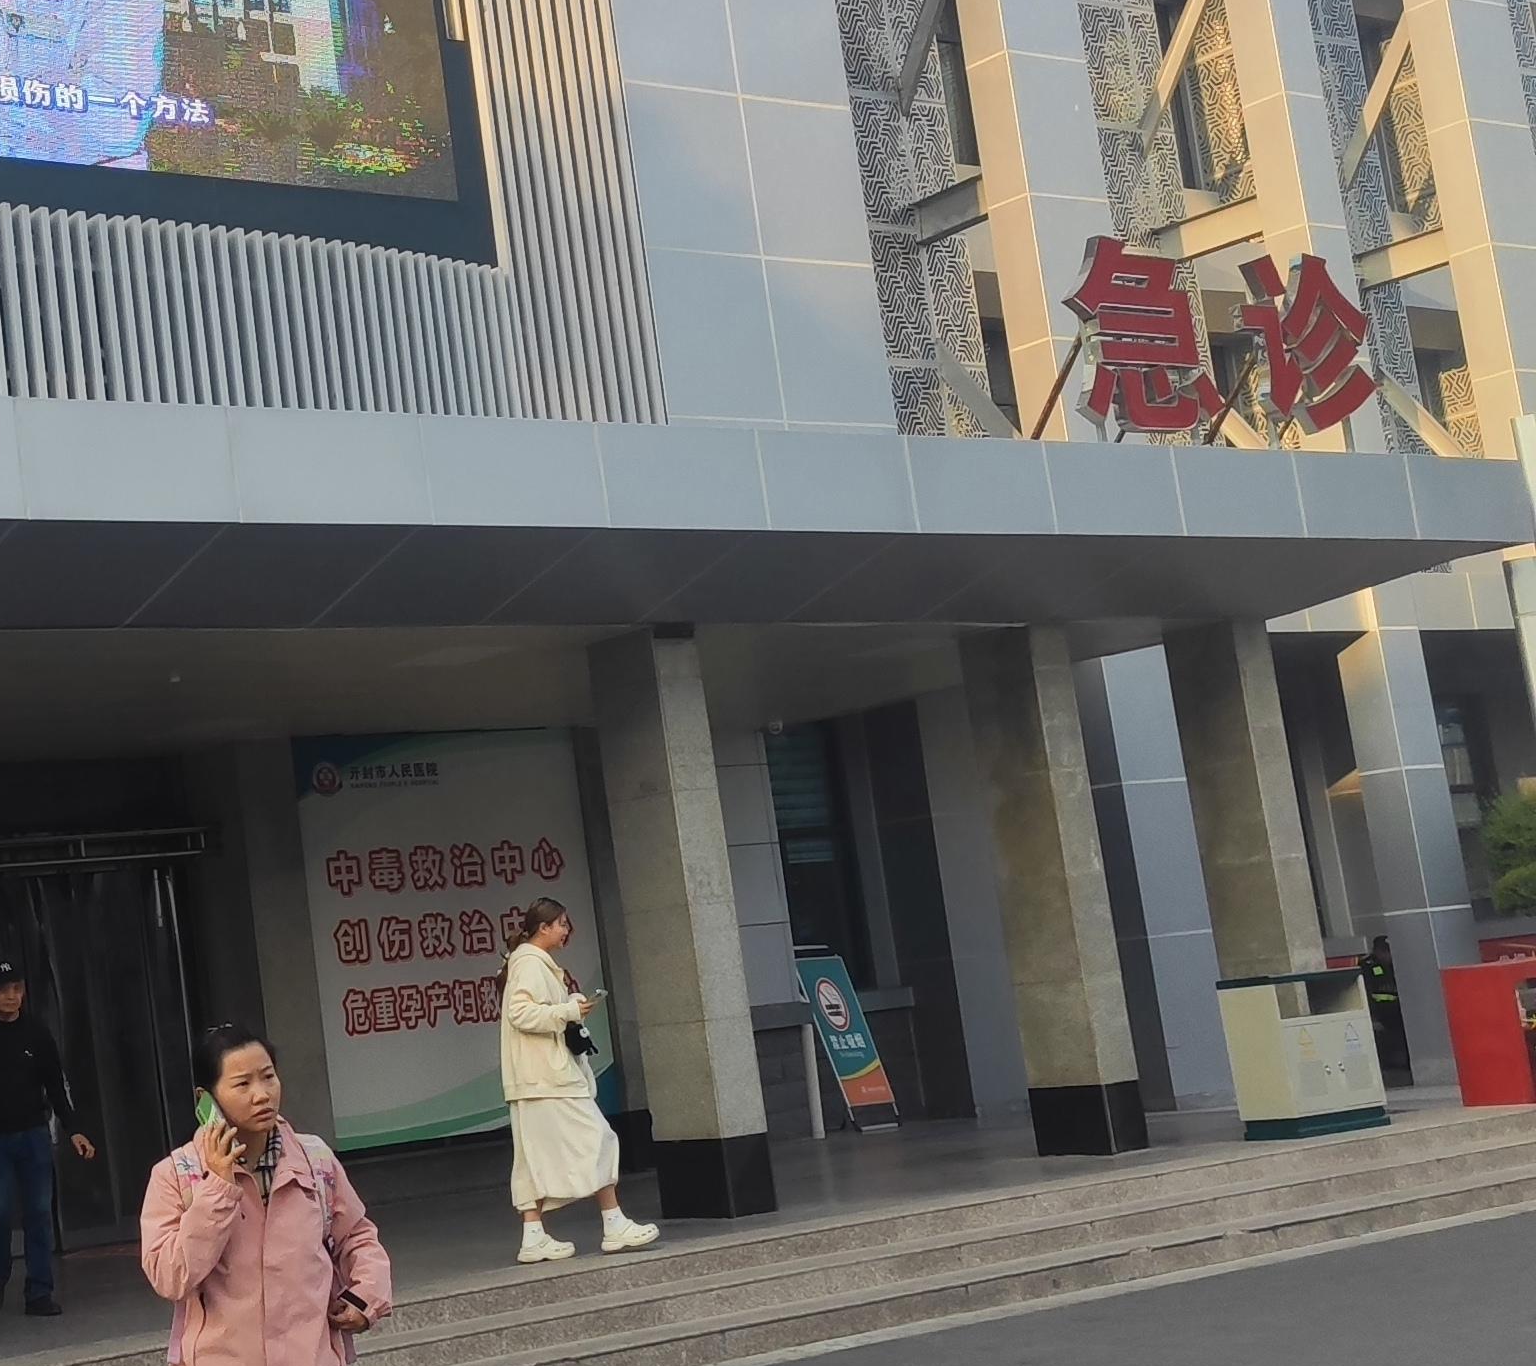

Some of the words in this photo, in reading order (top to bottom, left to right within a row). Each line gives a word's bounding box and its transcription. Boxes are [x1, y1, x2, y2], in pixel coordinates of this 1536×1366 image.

[1061, 235, 1378, 434] 急诊
[326, 837, 564, 897] 中毒救治中心
[333, 906, 573, 965] 创伤救治中
